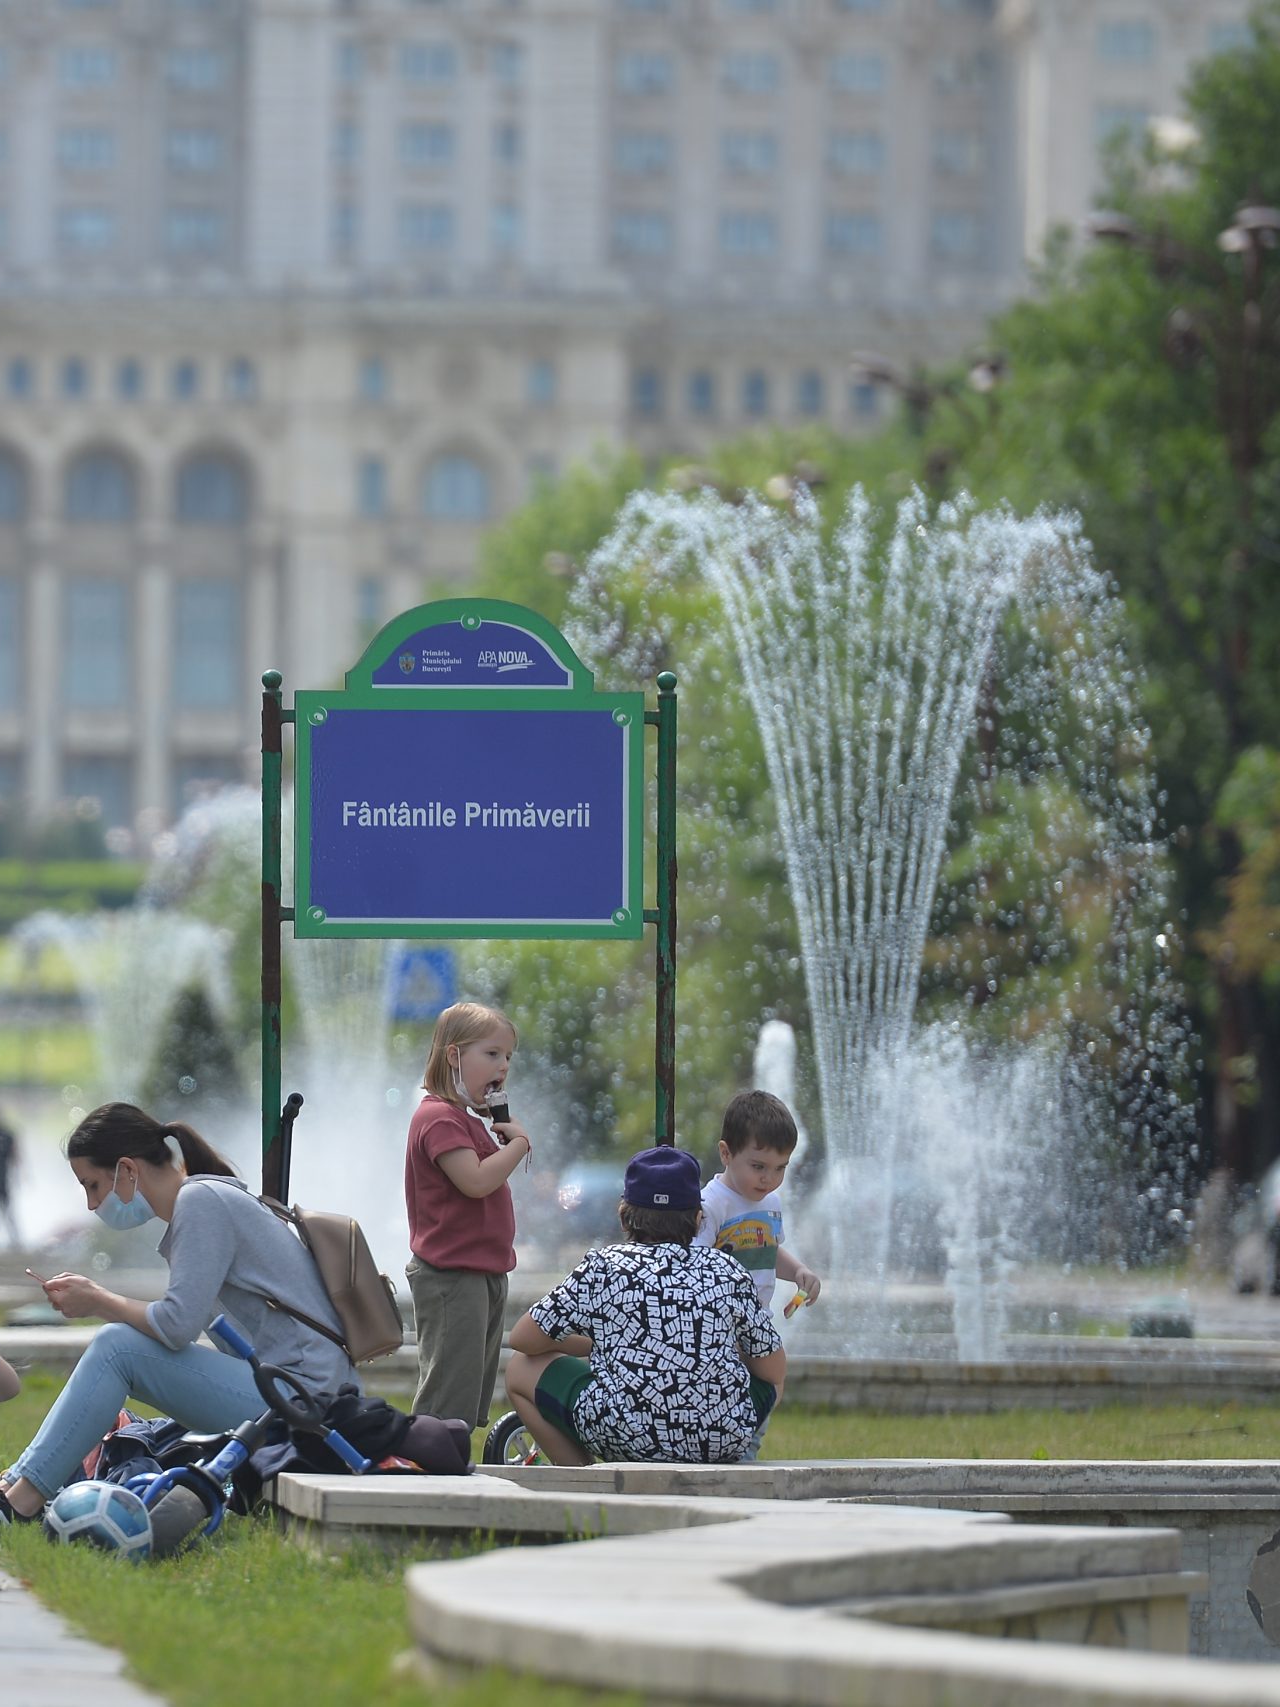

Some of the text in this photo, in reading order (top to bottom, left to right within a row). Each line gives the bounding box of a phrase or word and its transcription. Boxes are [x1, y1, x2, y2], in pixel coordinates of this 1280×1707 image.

[478, 651, 528, 663] APA NOVA
[342, 801, 590, 827] Fântânile Primăverii
[695, 1281, 735, 1308] URBAN
[680, 1311, 695, 1353] FREE
[616, 1347, 656, 1367] FREE
[642, 1337, 696, 1371] URBAN
